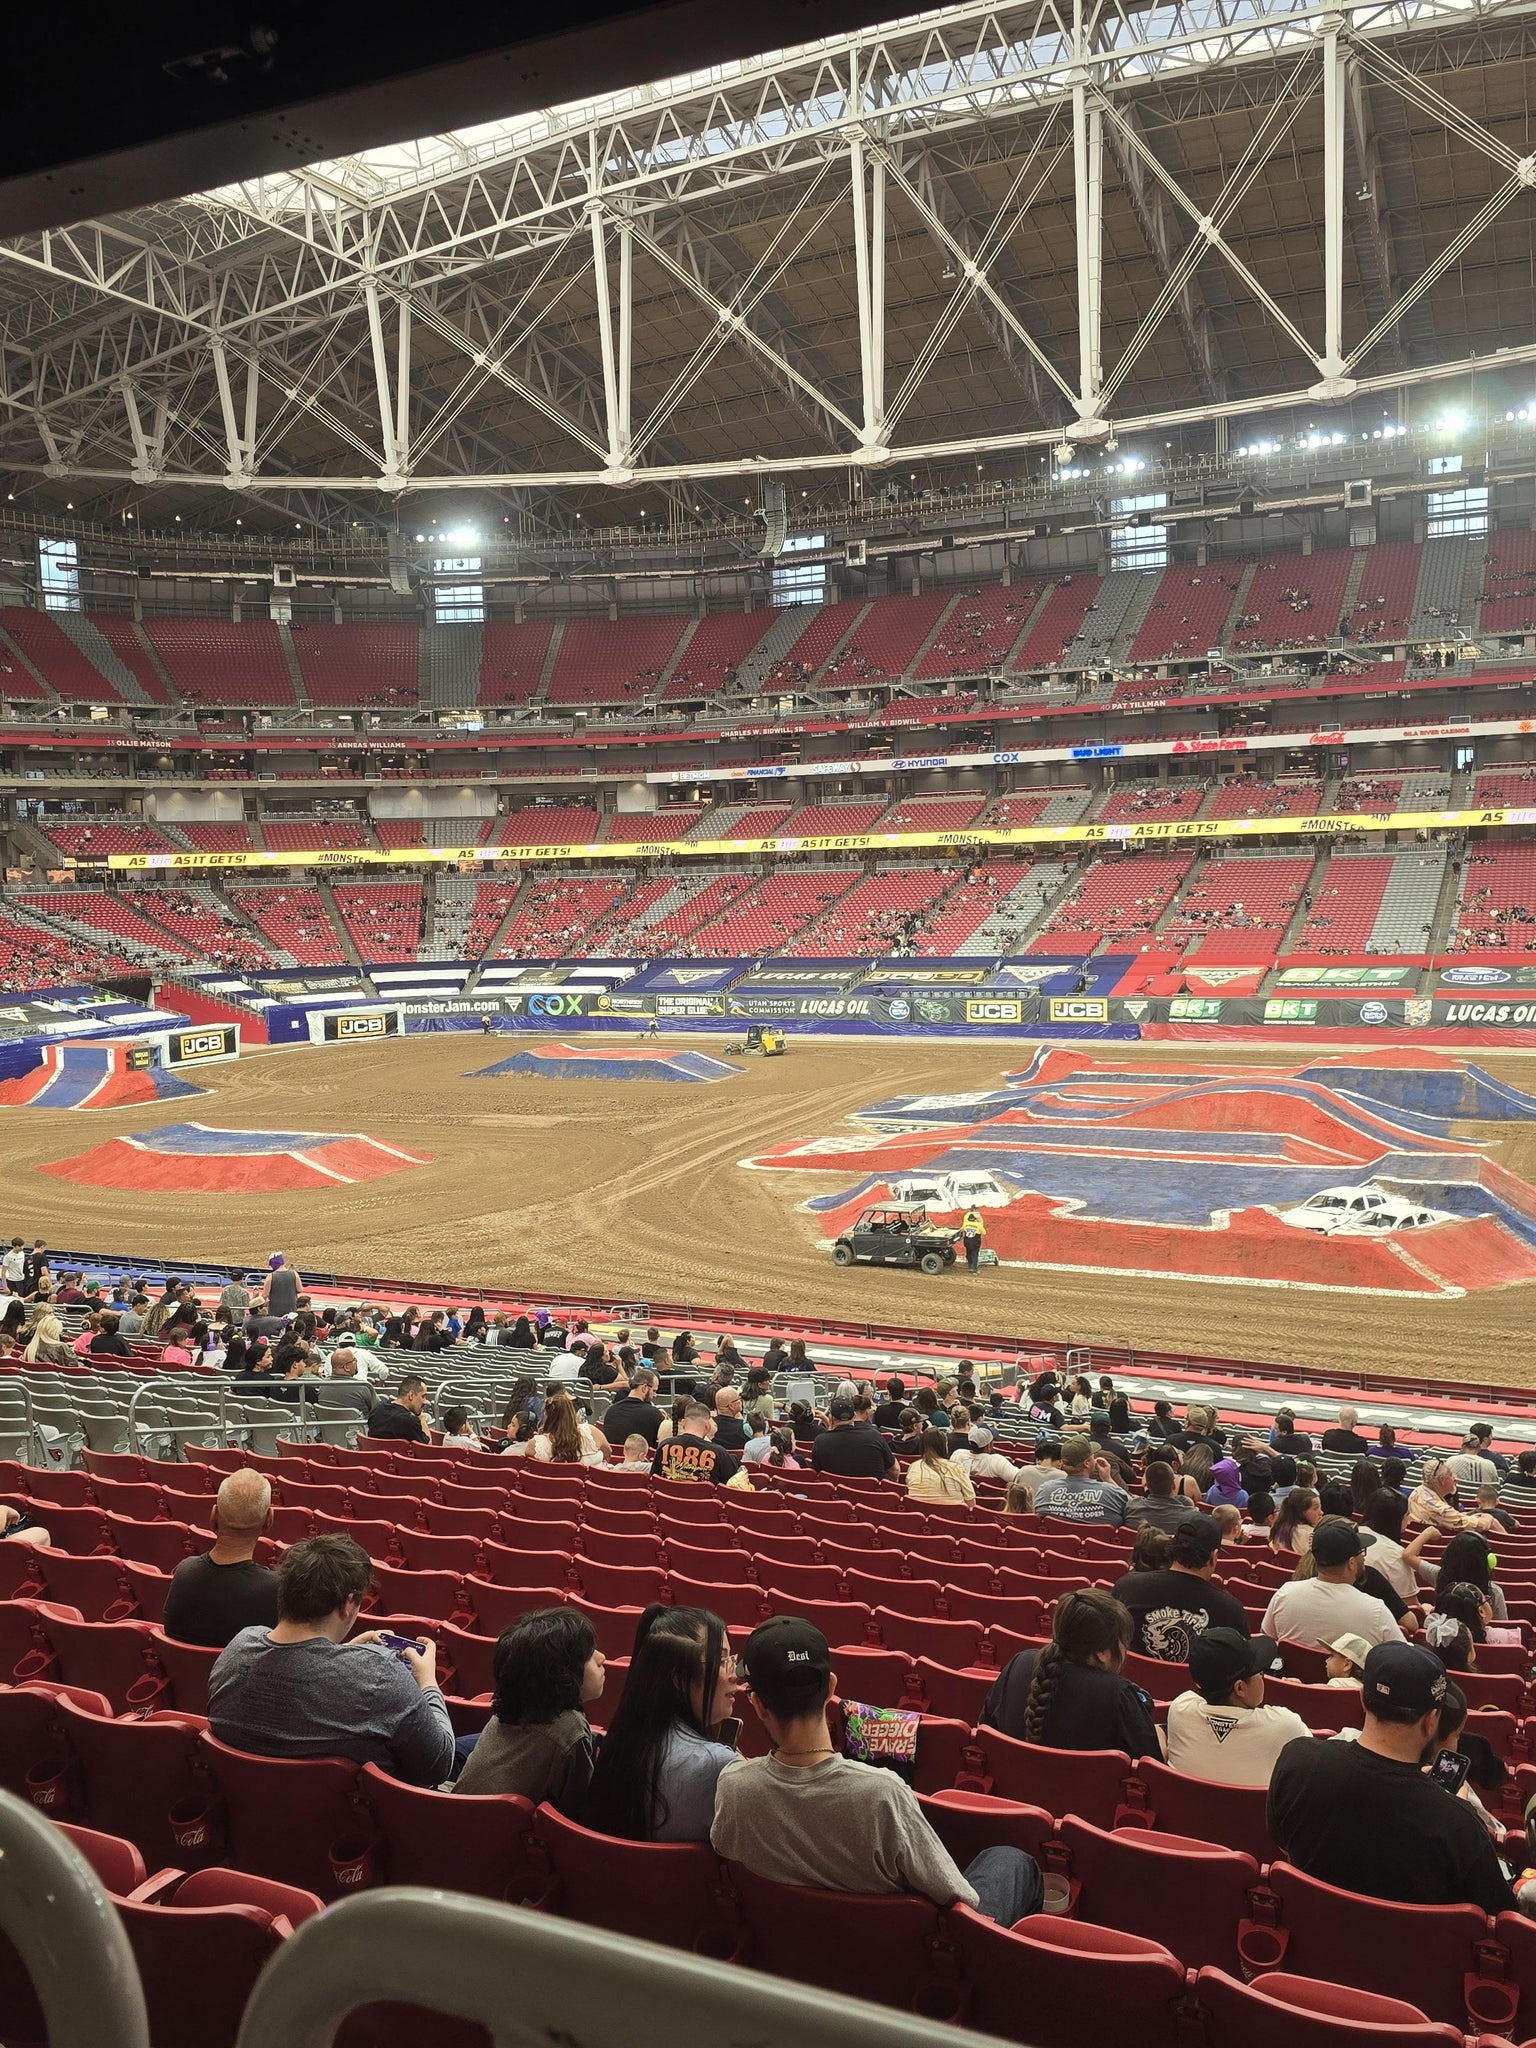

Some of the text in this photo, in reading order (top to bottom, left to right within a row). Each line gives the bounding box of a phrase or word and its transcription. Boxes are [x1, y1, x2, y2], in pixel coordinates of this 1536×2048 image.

[1129, 700, 1166, 708] TILLMAN
[847, 721, 880, 729] WILLIAM
[890, 718, 921, 726] BIDWILL
[720, 729, 751, 738] CHARLES
[1440, 728, 1469, 736] CASINOS
[1189, 739, 1247, 752] State Farm
[1073, 747, 1122, 758] BUD LIGHT
[907, 758, 948, 768] HYUNDAI
[993, 753, 1019, 763] COX
[747, 769, 774, 777] FINANCIAL
[813, 763, 849, 774] SAFEWAY
[1480, 812, 1504, 822] AS
[1086, 827, 1104, 837] AS
[1135, 826, 1154, 836] AS
[1157, 825, 1171, 834] IT
[1176, 823, 1218, 834] GETS!
[760, 841, 776, 849] AS
[801, 839, 817, 848] AS
[819, 838, 833, 847] IT
[834, 837, 870, 847] GETS!
[458, 849, 475, 858] AS
[501, 849, 517, 857] AS
[520, 848, 532, 857] IT
[535, 847, 571, 856] GETS!
[129, 857, 146, 866] AS
[174, 857, 190, 865] AS
[193, 856, 206, 864] IT
[209, 855, 247, 864] GETS!
[749, 972, 855, 980] LUCAS OIL
[1281, 968, 1406, 981] BKT
[528, 994, 583, 1016] COX
[658, 997, 712, 1006] THE ORIGINAL
[658, 1006, 709, 1015] SUPER GLUE
[800, 1000, 869, 1015] LUCAS OIL
[971, 1004, 1018, 1019] JCB
[1054, 1003, 1103, 1017] JCB
[1170, 1000, 1221, 1017] BKT
[1264, 1001, 1318, 1018] BKT
[1446, 1004, 1536, 1023] LUCAS OI
[341, 1018, 383, 1033] JCB
[184, 1035, 222, 1054] JCB
[661, 1444, 717, 1471] 1986
[1084, 1510, 1105, 1519] OPEN
